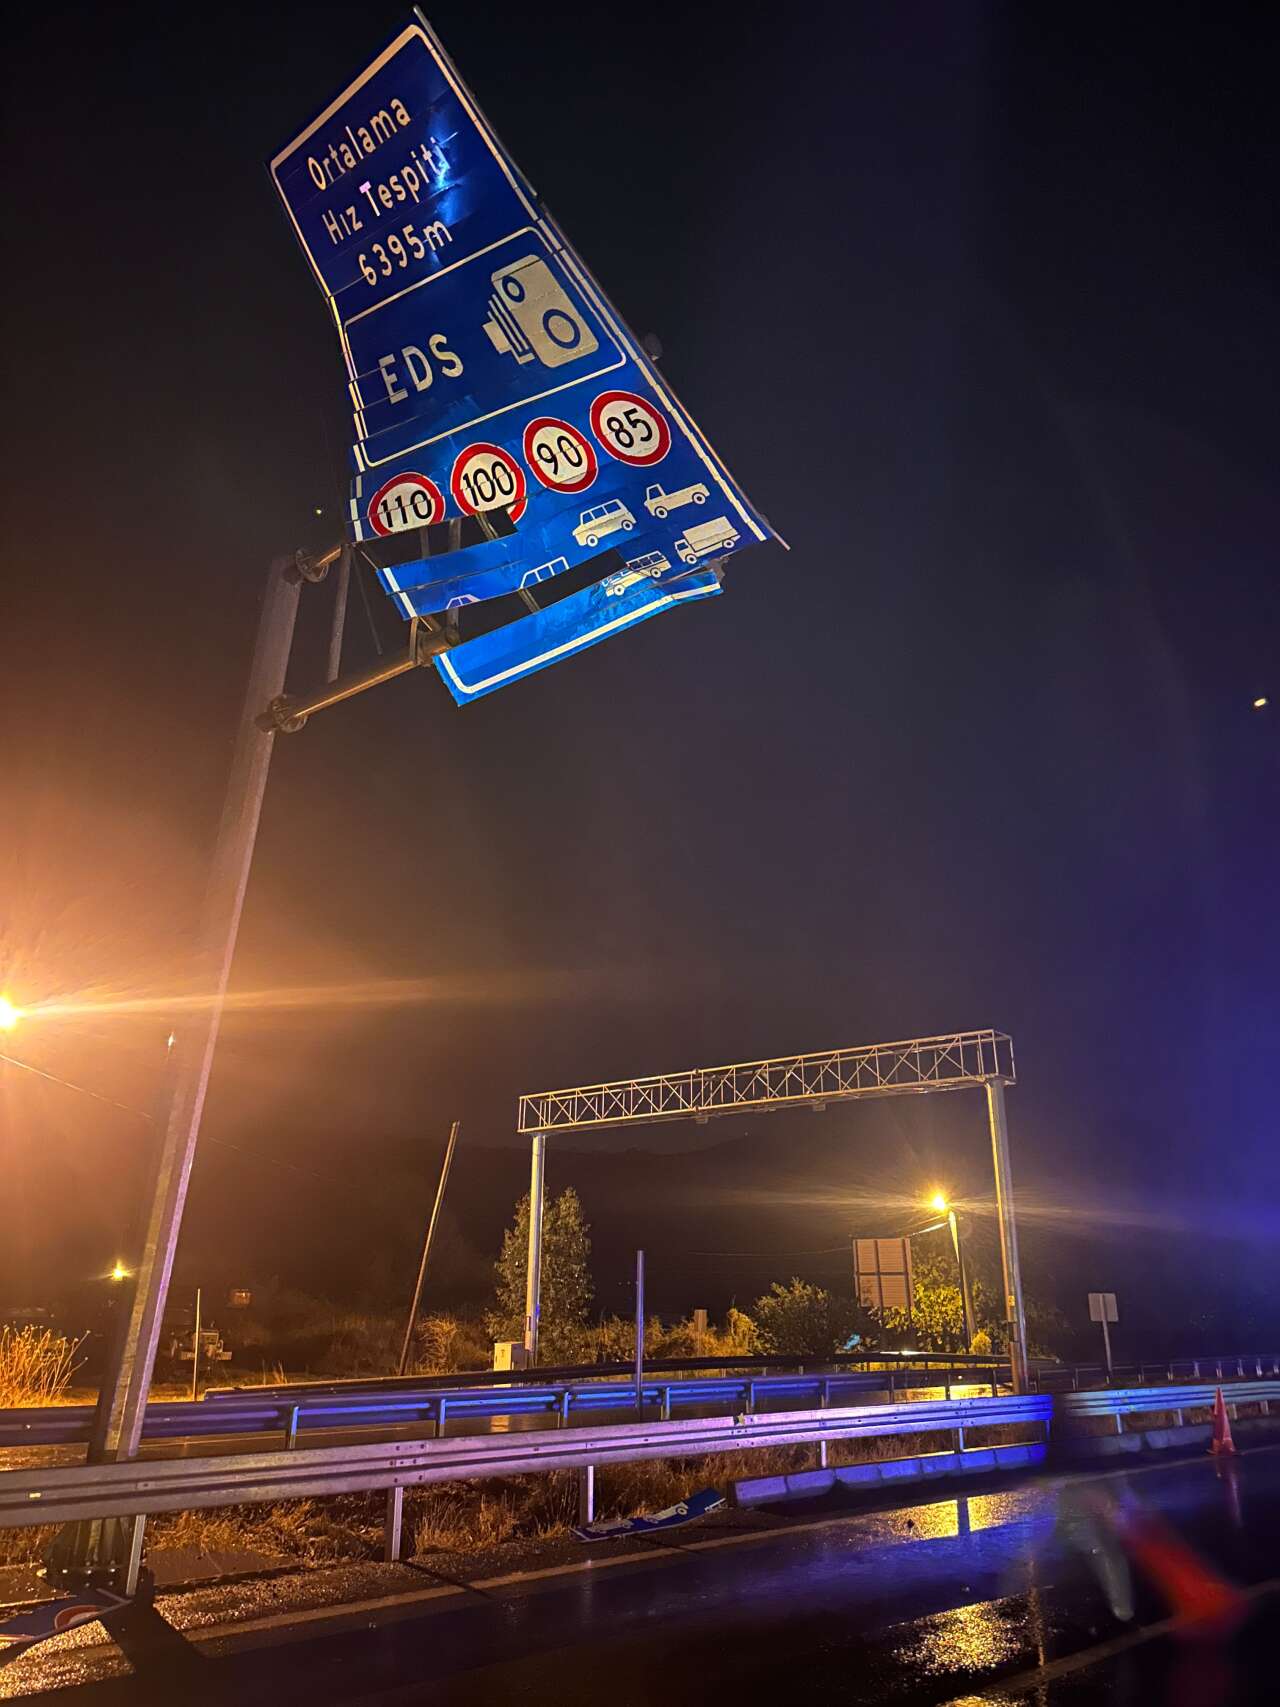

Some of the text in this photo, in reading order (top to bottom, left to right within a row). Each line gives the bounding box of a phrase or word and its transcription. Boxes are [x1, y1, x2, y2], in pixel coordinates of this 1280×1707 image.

[308, 98, 412, 191] Ortalama
[322, 205, 363, 246] Hız
[358, 219, 453, 286] 6395m
[379, 334, 464, 404] EDS
[380, 407, 653, 528] 110 100 90 85
